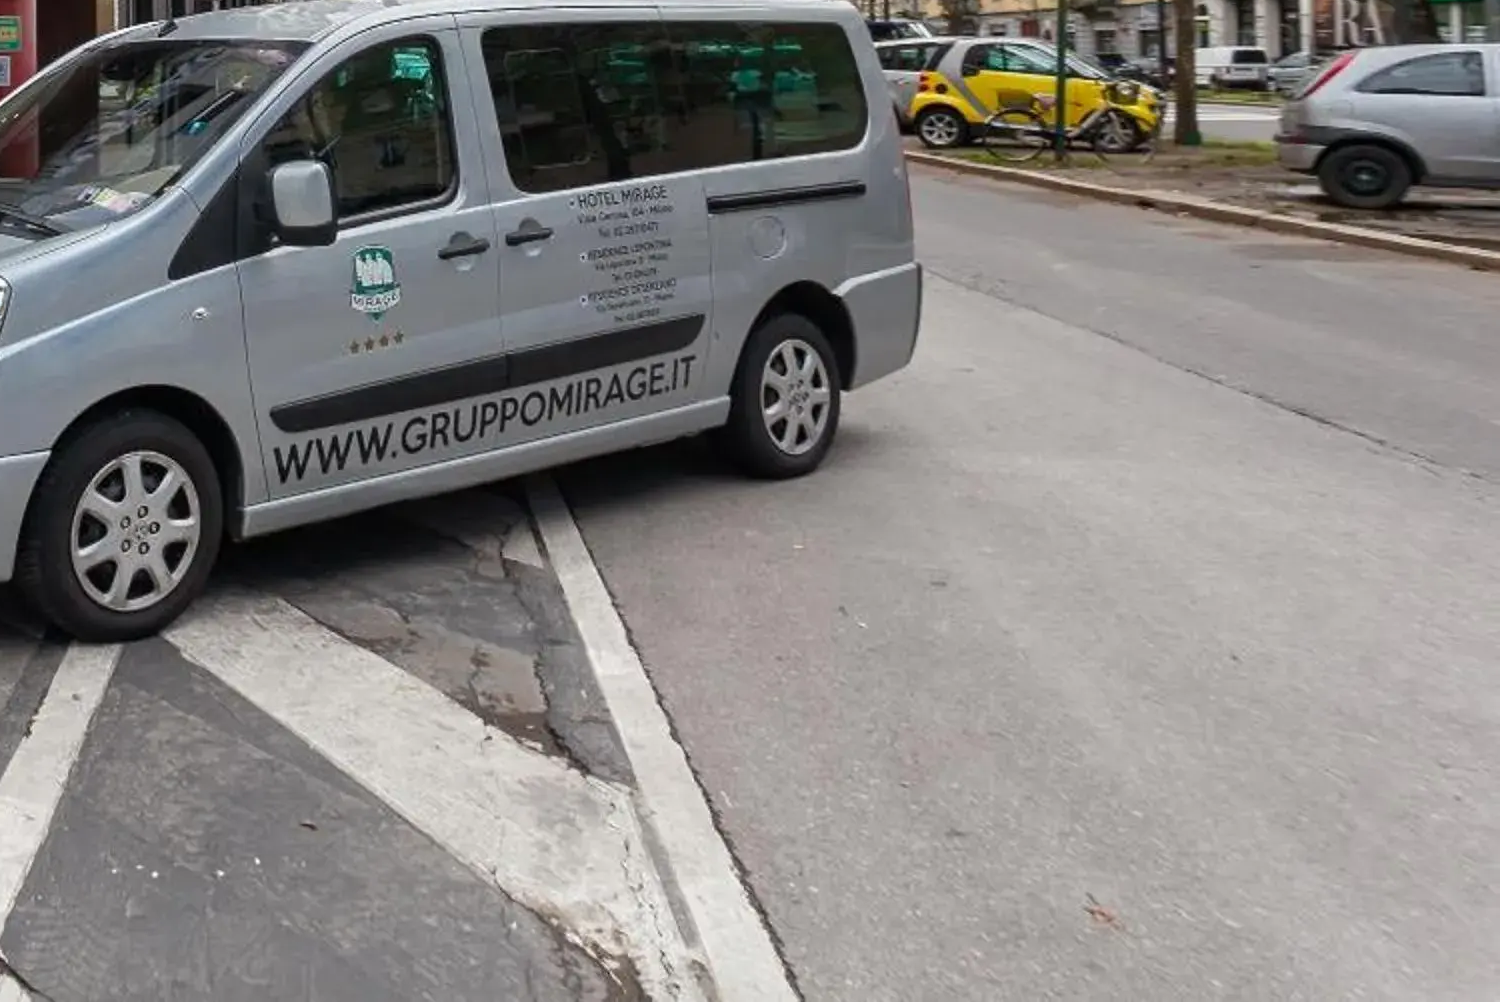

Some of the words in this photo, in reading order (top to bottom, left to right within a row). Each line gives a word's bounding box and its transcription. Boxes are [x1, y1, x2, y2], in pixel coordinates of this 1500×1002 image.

[578, 190, 620, 208] HOTEL
[621, 184, 668, 203] MIRAGE
[273, 354, 697, 484] WWW.GRUPPOMIRAGE.IT
